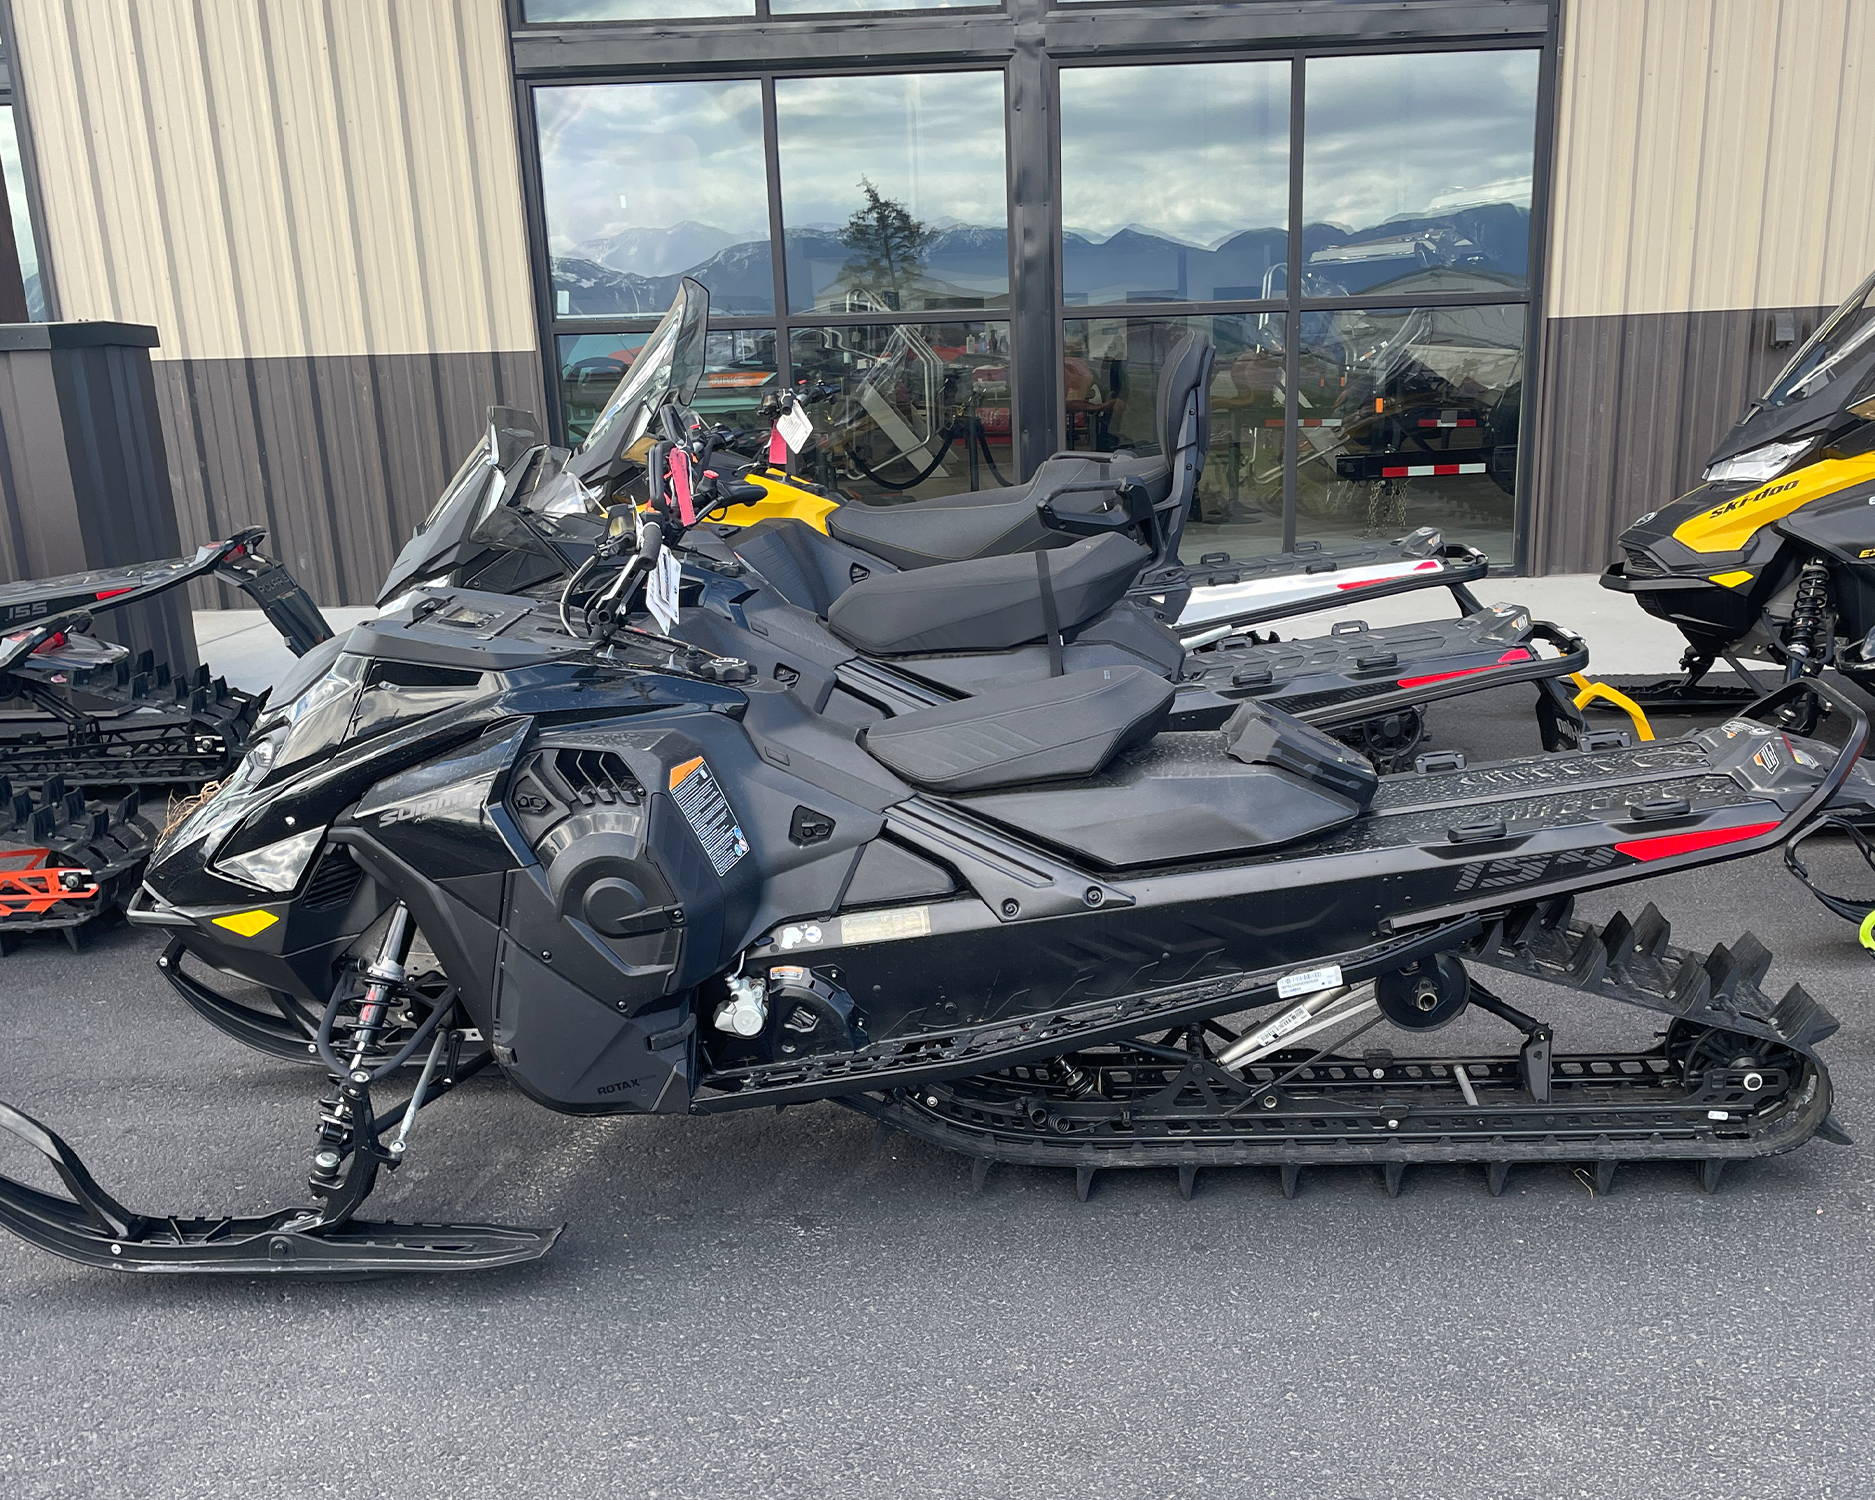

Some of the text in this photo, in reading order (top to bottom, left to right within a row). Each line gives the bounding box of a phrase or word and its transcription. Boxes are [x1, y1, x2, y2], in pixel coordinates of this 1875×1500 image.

[8, 602, 48, 621] 155
[1453, 846, 1618, 892] 154
[597, 1078, 640, 1095] ROTAX
